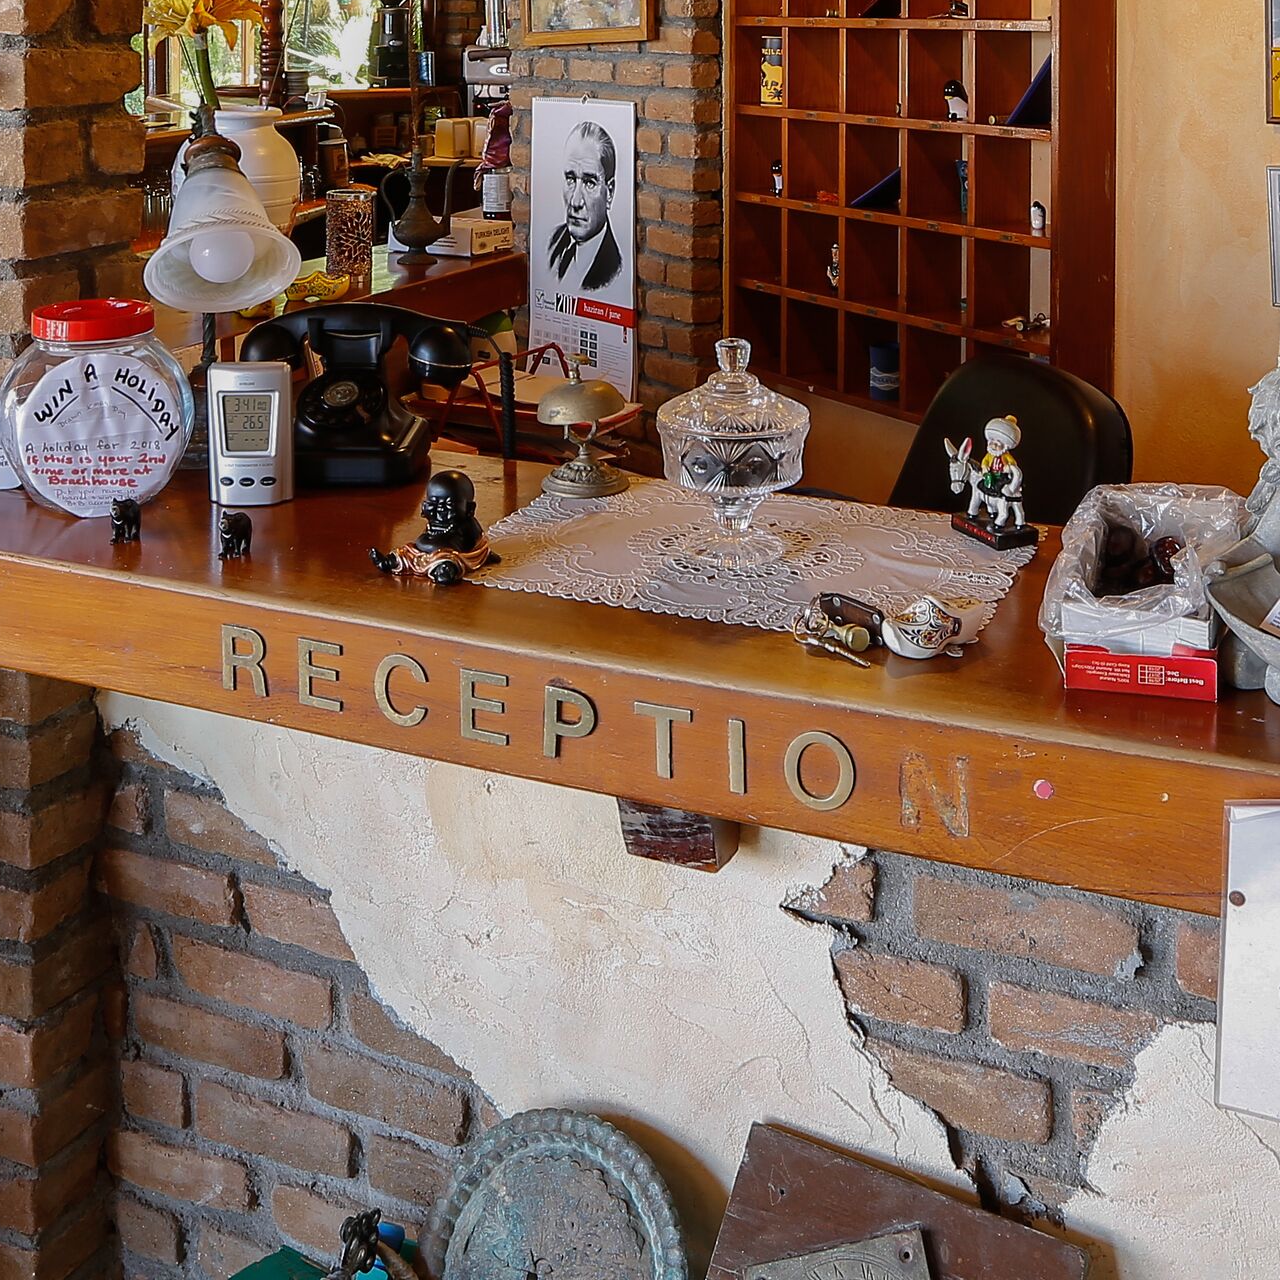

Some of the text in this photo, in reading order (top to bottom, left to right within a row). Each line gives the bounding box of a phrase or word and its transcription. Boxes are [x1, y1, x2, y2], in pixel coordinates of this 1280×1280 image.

[475, 227, 509, 239] TURKISH DELIGHT
[556, 293, 577, 316] 2017
[34, 379, 73, 422] WIN
[84, 363, 97, 383] A
[26, 440, 161, 455] A holiday for 2018
[44, 455, 73, 465] this
[98, 456, 132, 467] your
[137, 453, 167, 464] 2nd
[32, 467, 65, 476] time
[133, 467, 153, 475] at
[221, 623, 969, 837] RECEPTION
